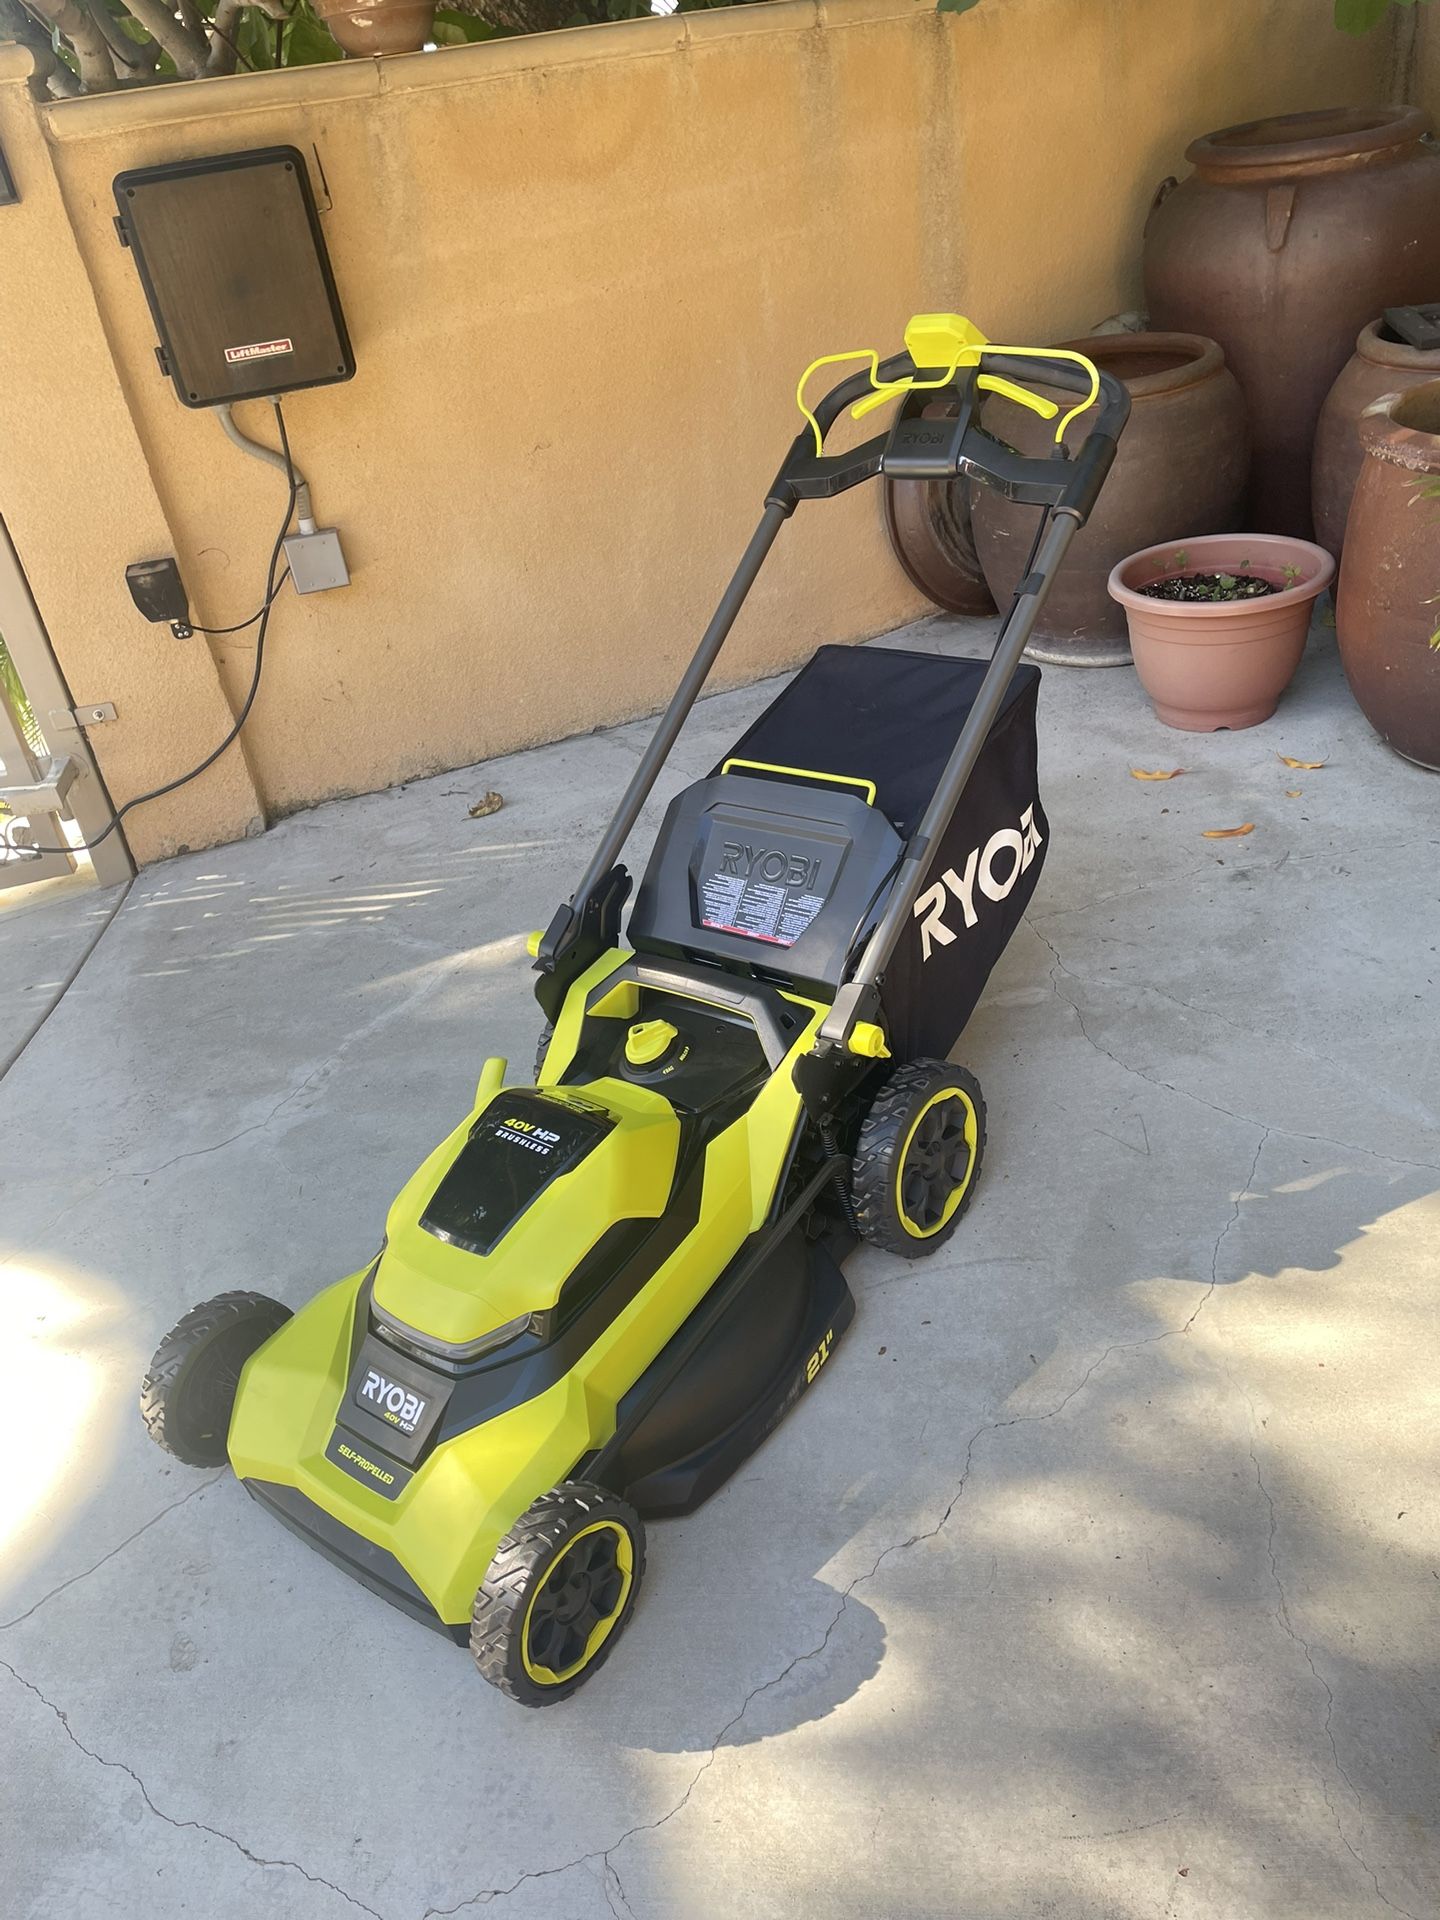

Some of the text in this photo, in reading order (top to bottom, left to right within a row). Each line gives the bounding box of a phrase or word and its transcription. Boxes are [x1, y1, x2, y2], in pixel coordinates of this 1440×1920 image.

[230, 343, 288, 359] LiftMaster
[902, 432, 945, 446] RYOBI
[719, 841, 822, 890] RYOBI
[494, 1129, 550, 1155] BRUSHLESS
[504, 1118, 560, 1143] 40V HP
[361, 1371, 426, 1425] RYOBI
[384, 1411, 415, 1432] 40V HP
[338, 1444, 395, 1485] SELF-PROPELLED
